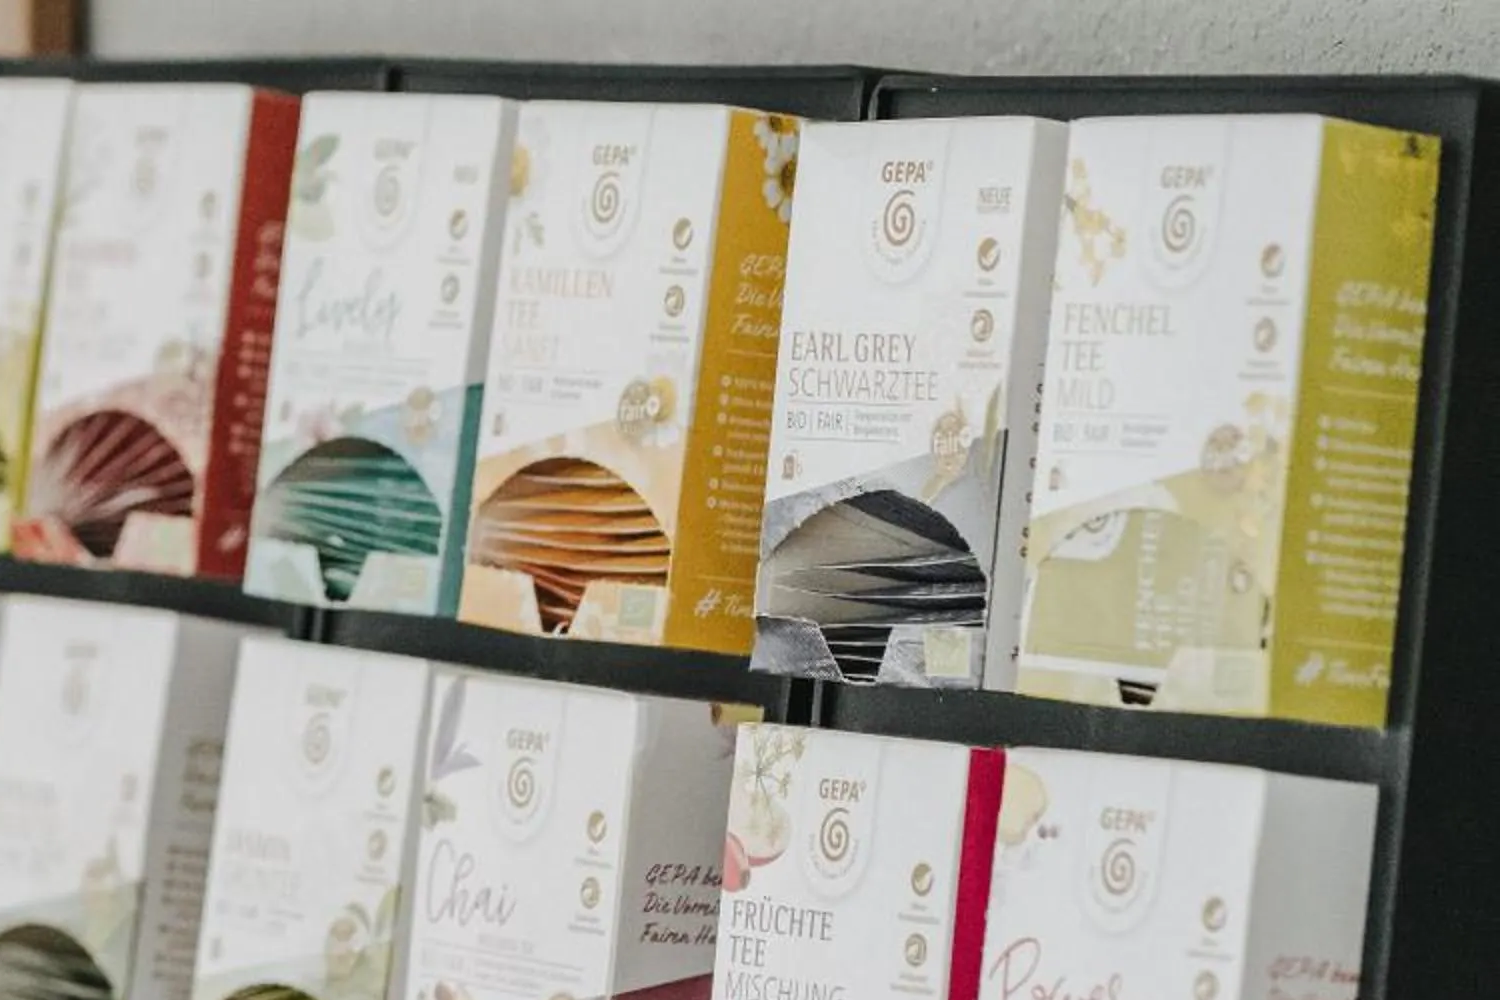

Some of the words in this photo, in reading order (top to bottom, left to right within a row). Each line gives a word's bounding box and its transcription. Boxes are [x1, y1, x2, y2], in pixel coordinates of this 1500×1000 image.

[1063, 301, 1175, 336] FENCHEL
[791, 331, 849, 363] EARL
[853, 333, 917, 363] GREY
[1061, 341, 1105, 371] TEE
[788, 367, 939, 401] SCHWARZTEE
[1056, 377, 1115, 410] MILD
[426, 838, 516, 927] Chai
[730, 895, 834, 942] FRÜCHTE
[729, 935, 768, 968] TEE
